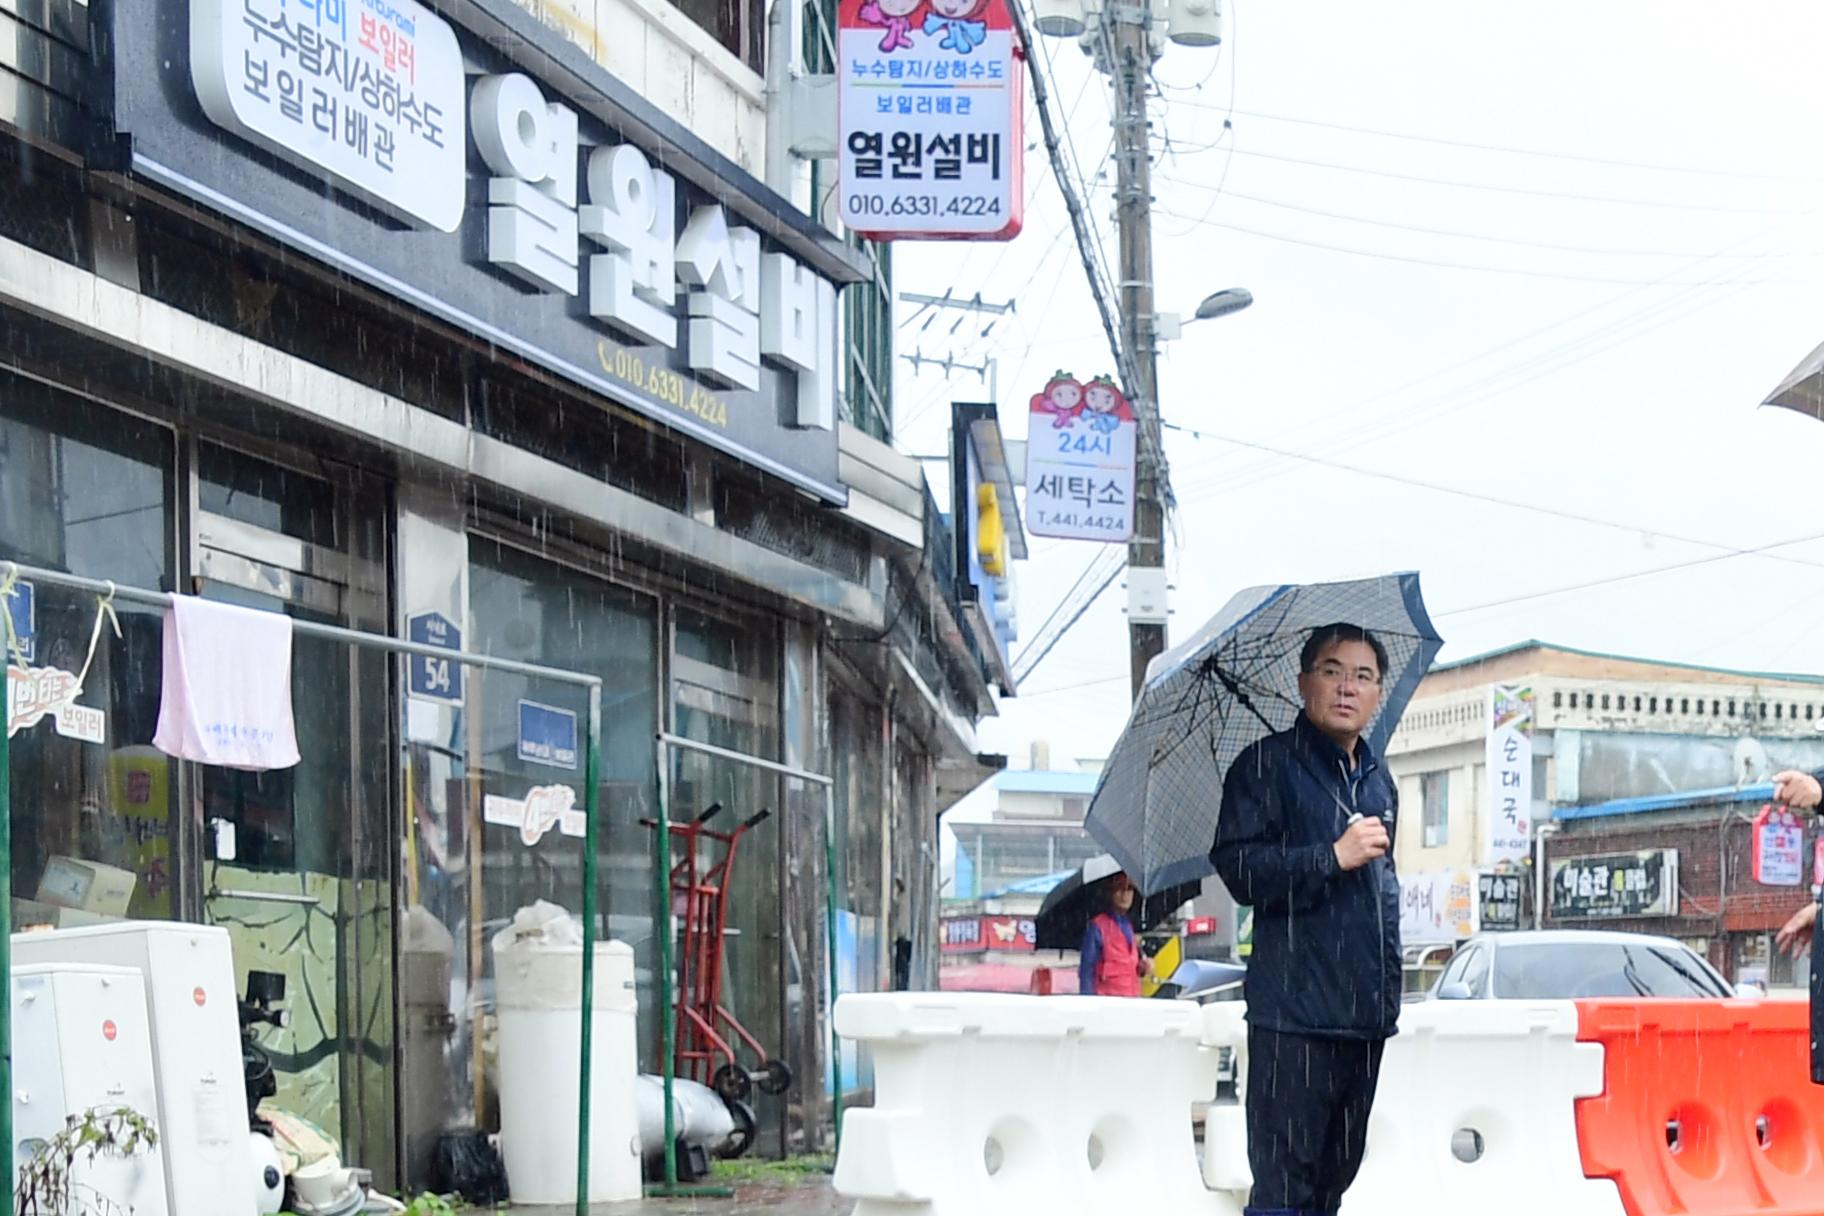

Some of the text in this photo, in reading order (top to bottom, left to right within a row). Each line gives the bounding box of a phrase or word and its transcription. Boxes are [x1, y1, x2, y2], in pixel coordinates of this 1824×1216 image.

[358, 11, 414, 86] 보일러
[851, 59, 1004, 80] 누수탐지/상하수도
[243, 49, 395, 174] 보일러배관
[876, 95, 972, 115] 보일러배관
[847, 130, 1001, 181] 열원설비
[849, 194, 1001, 217] 010.6331.4224
[470, 71, 834, 431] 열원설비
[615, 348, 728, 428] 010.6331.4224
[1058, 431, 1112, 456] 24시
[1033, 474, 1126, 509] 세탁소
[1037, 510, 1125, 531] T.441.4424
[424, 656, 451, 693] 54
[62, 706, 102, 740] 보일러
[1502, 735, 1522, 825] 순대국
